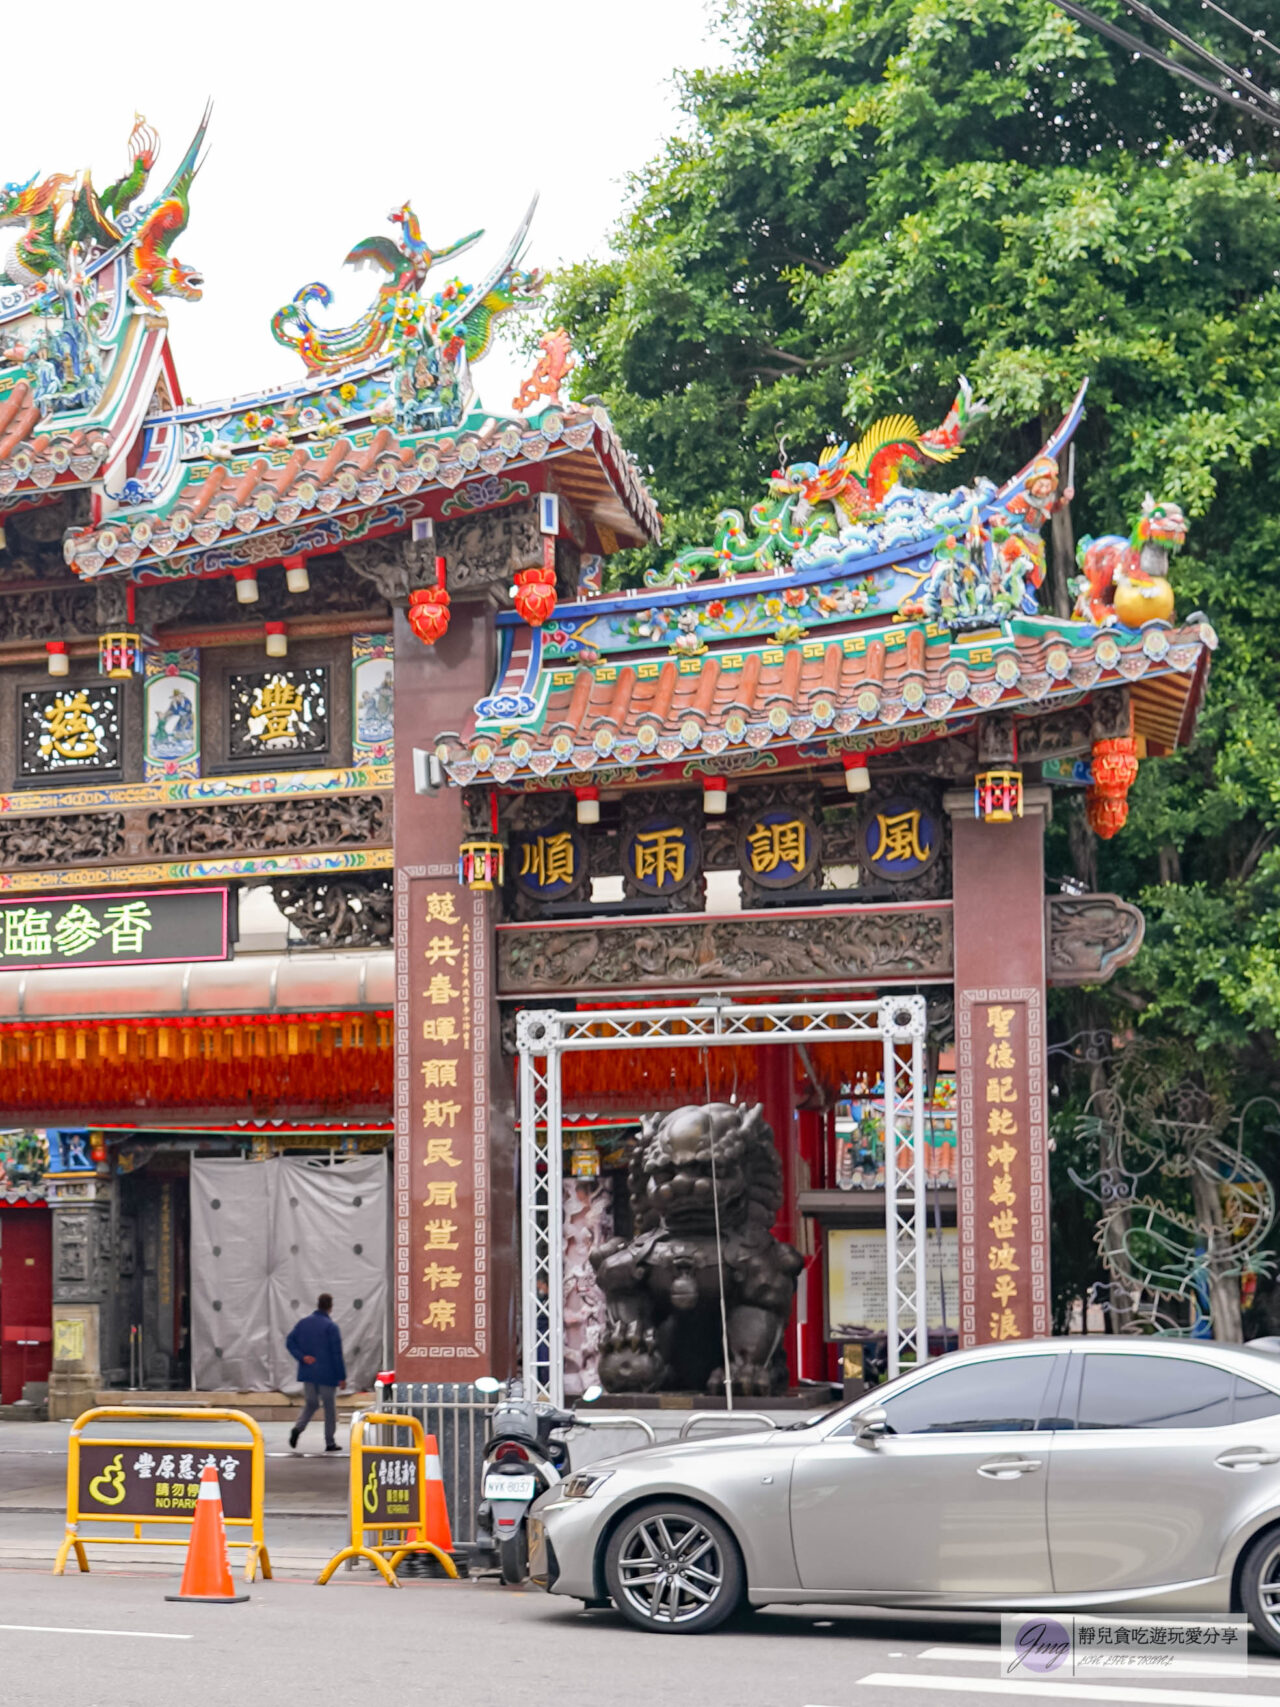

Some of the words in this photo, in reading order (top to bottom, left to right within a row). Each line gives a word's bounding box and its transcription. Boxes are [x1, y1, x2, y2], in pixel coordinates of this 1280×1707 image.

[986, 1005, 1021, 1341] 聖德配乾坤萬世波平浪
[156, 1482, 200, 1497] 請勿停
[155, 1498, 170, 1508] NO
[172, 1498, 197, 1509] PARK
